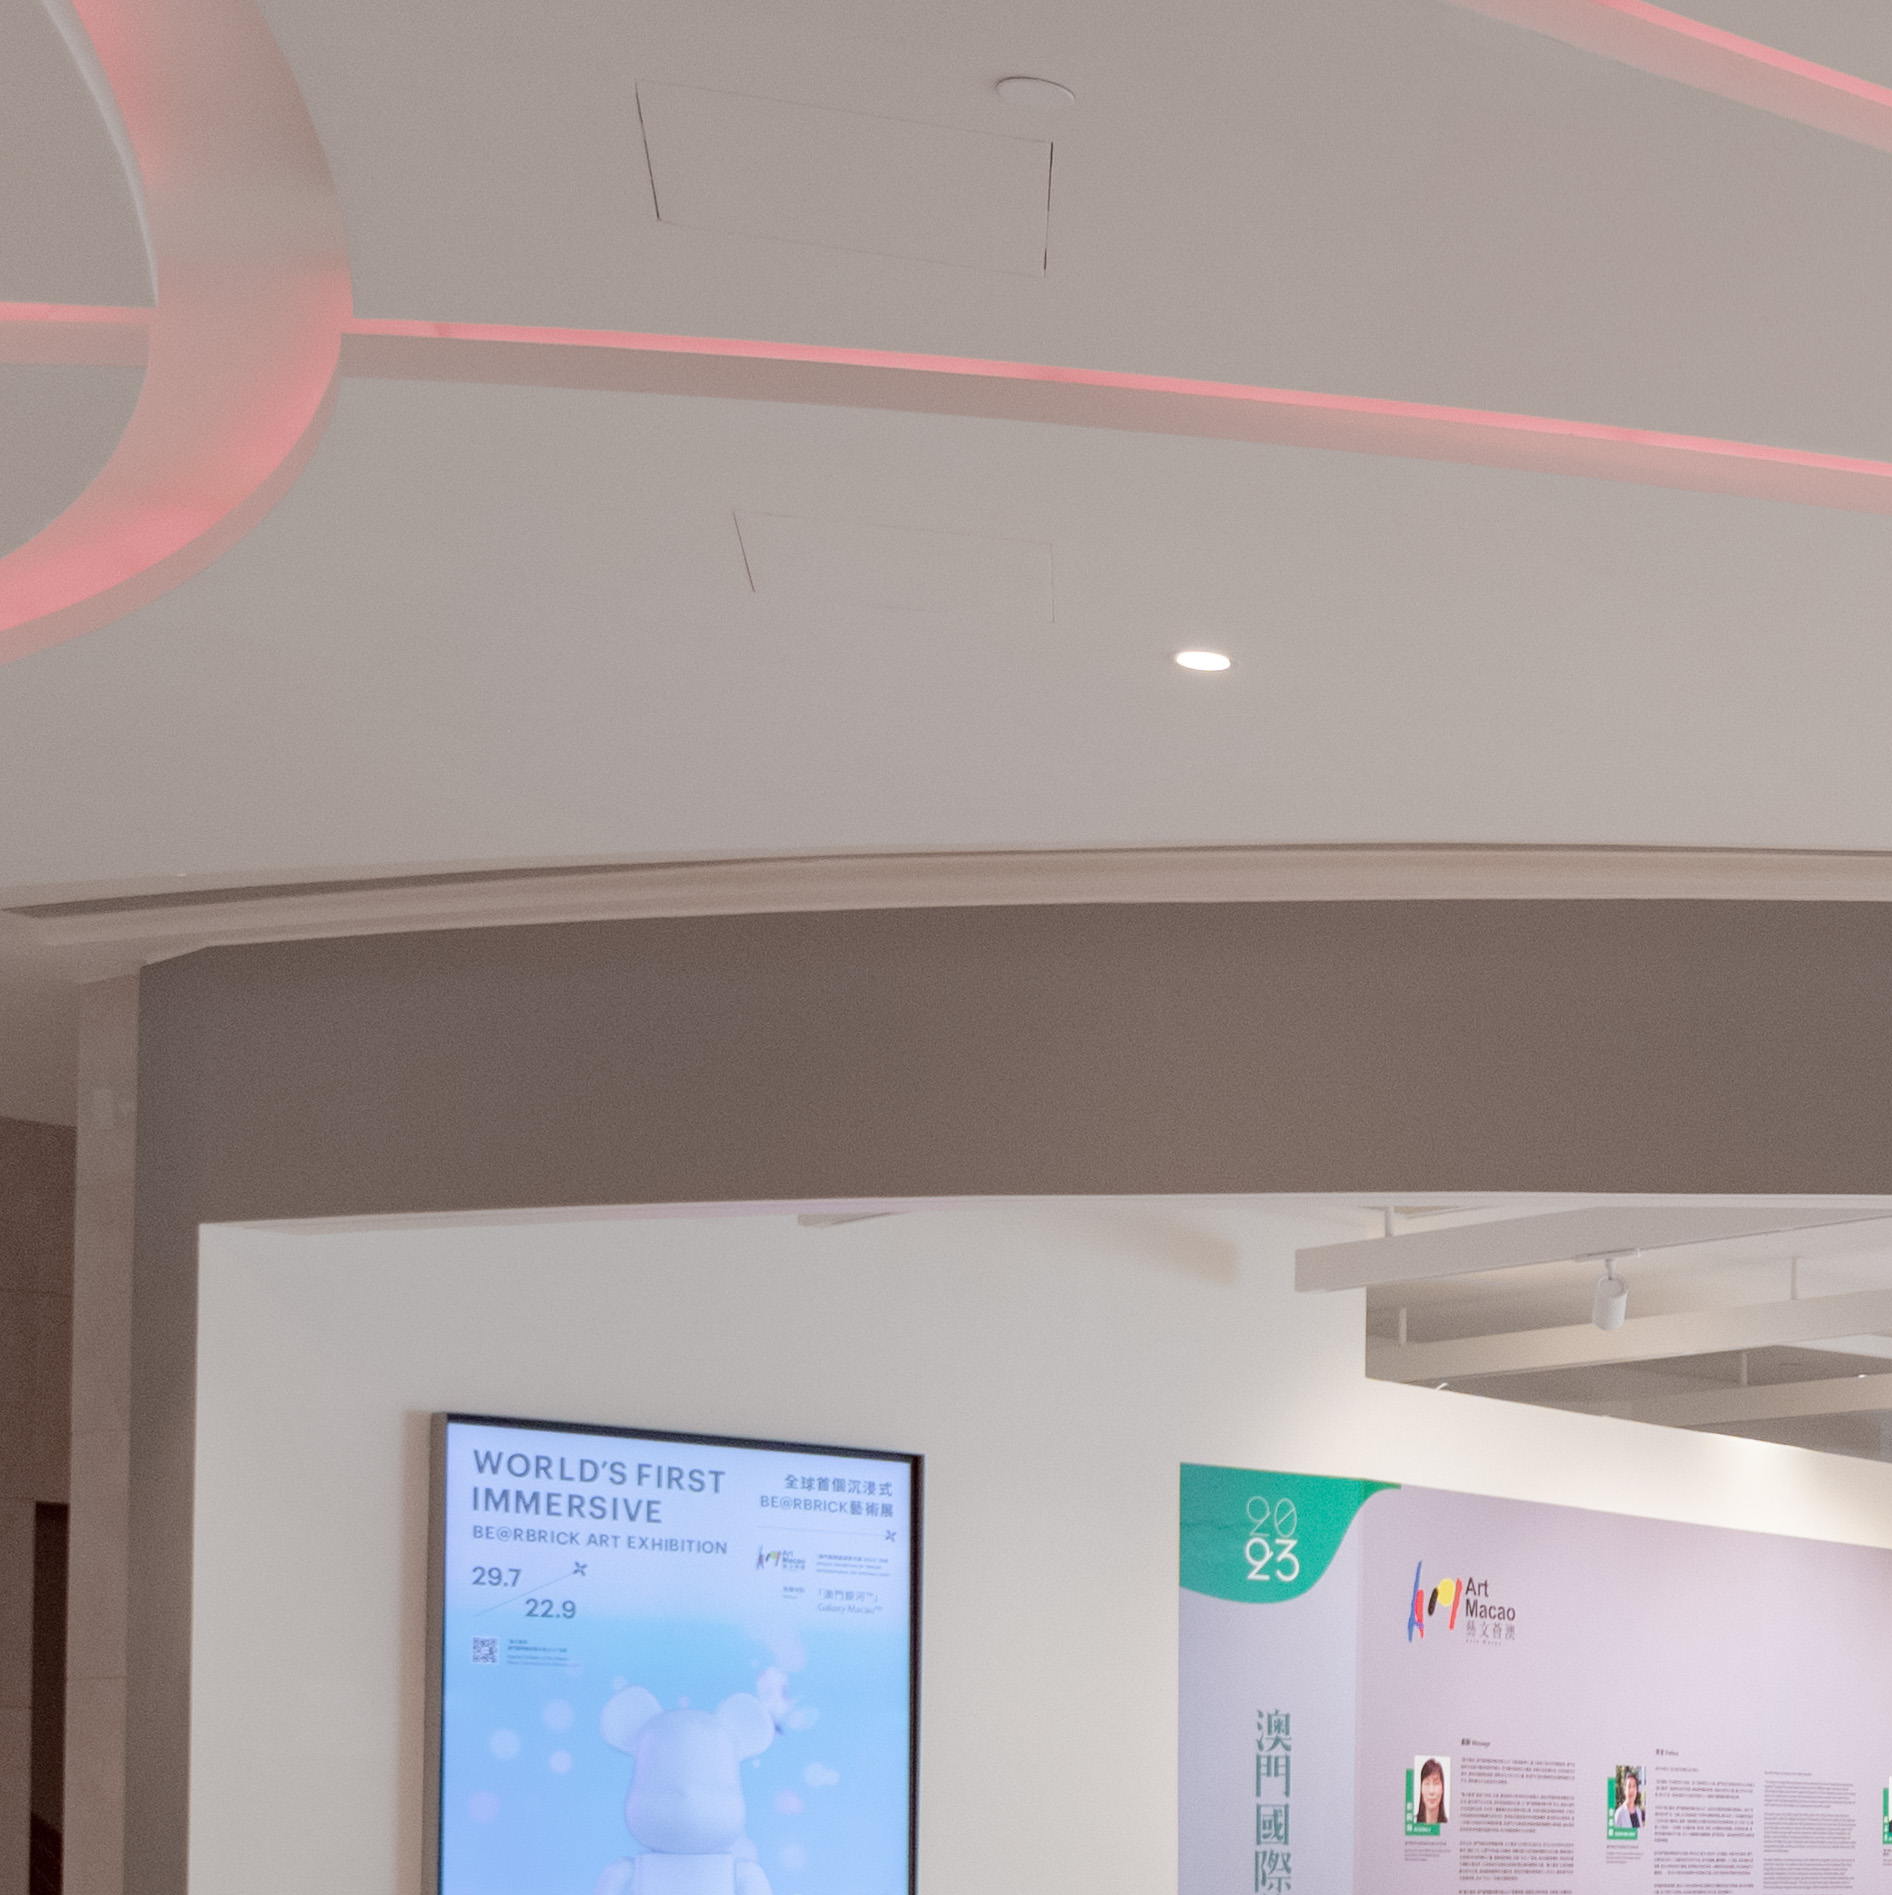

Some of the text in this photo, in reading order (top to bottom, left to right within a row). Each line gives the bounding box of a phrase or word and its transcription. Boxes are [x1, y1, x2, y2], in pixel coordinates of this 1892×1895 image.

[474, 1450, 725, 1493] WORLD'S FIRST
[785, 1474, 893, 1497] 全球首個沉浸式
[472, 1487, 662, 1523] IMMERSIVE
[1246, 1495, 1297, 1538] 20
[473, 1525, 727, 1554] BE@RBRICK ART EXHIBITION
[1245, 1537, 1300, 1582] 23
[472, 1567, 520, 1587] 29.7
[1465, 1577, 1489, 1597] Art
[525, 1598, 576, 1619] 22.9
[1465, 1599, 1516, 1621] Macao
